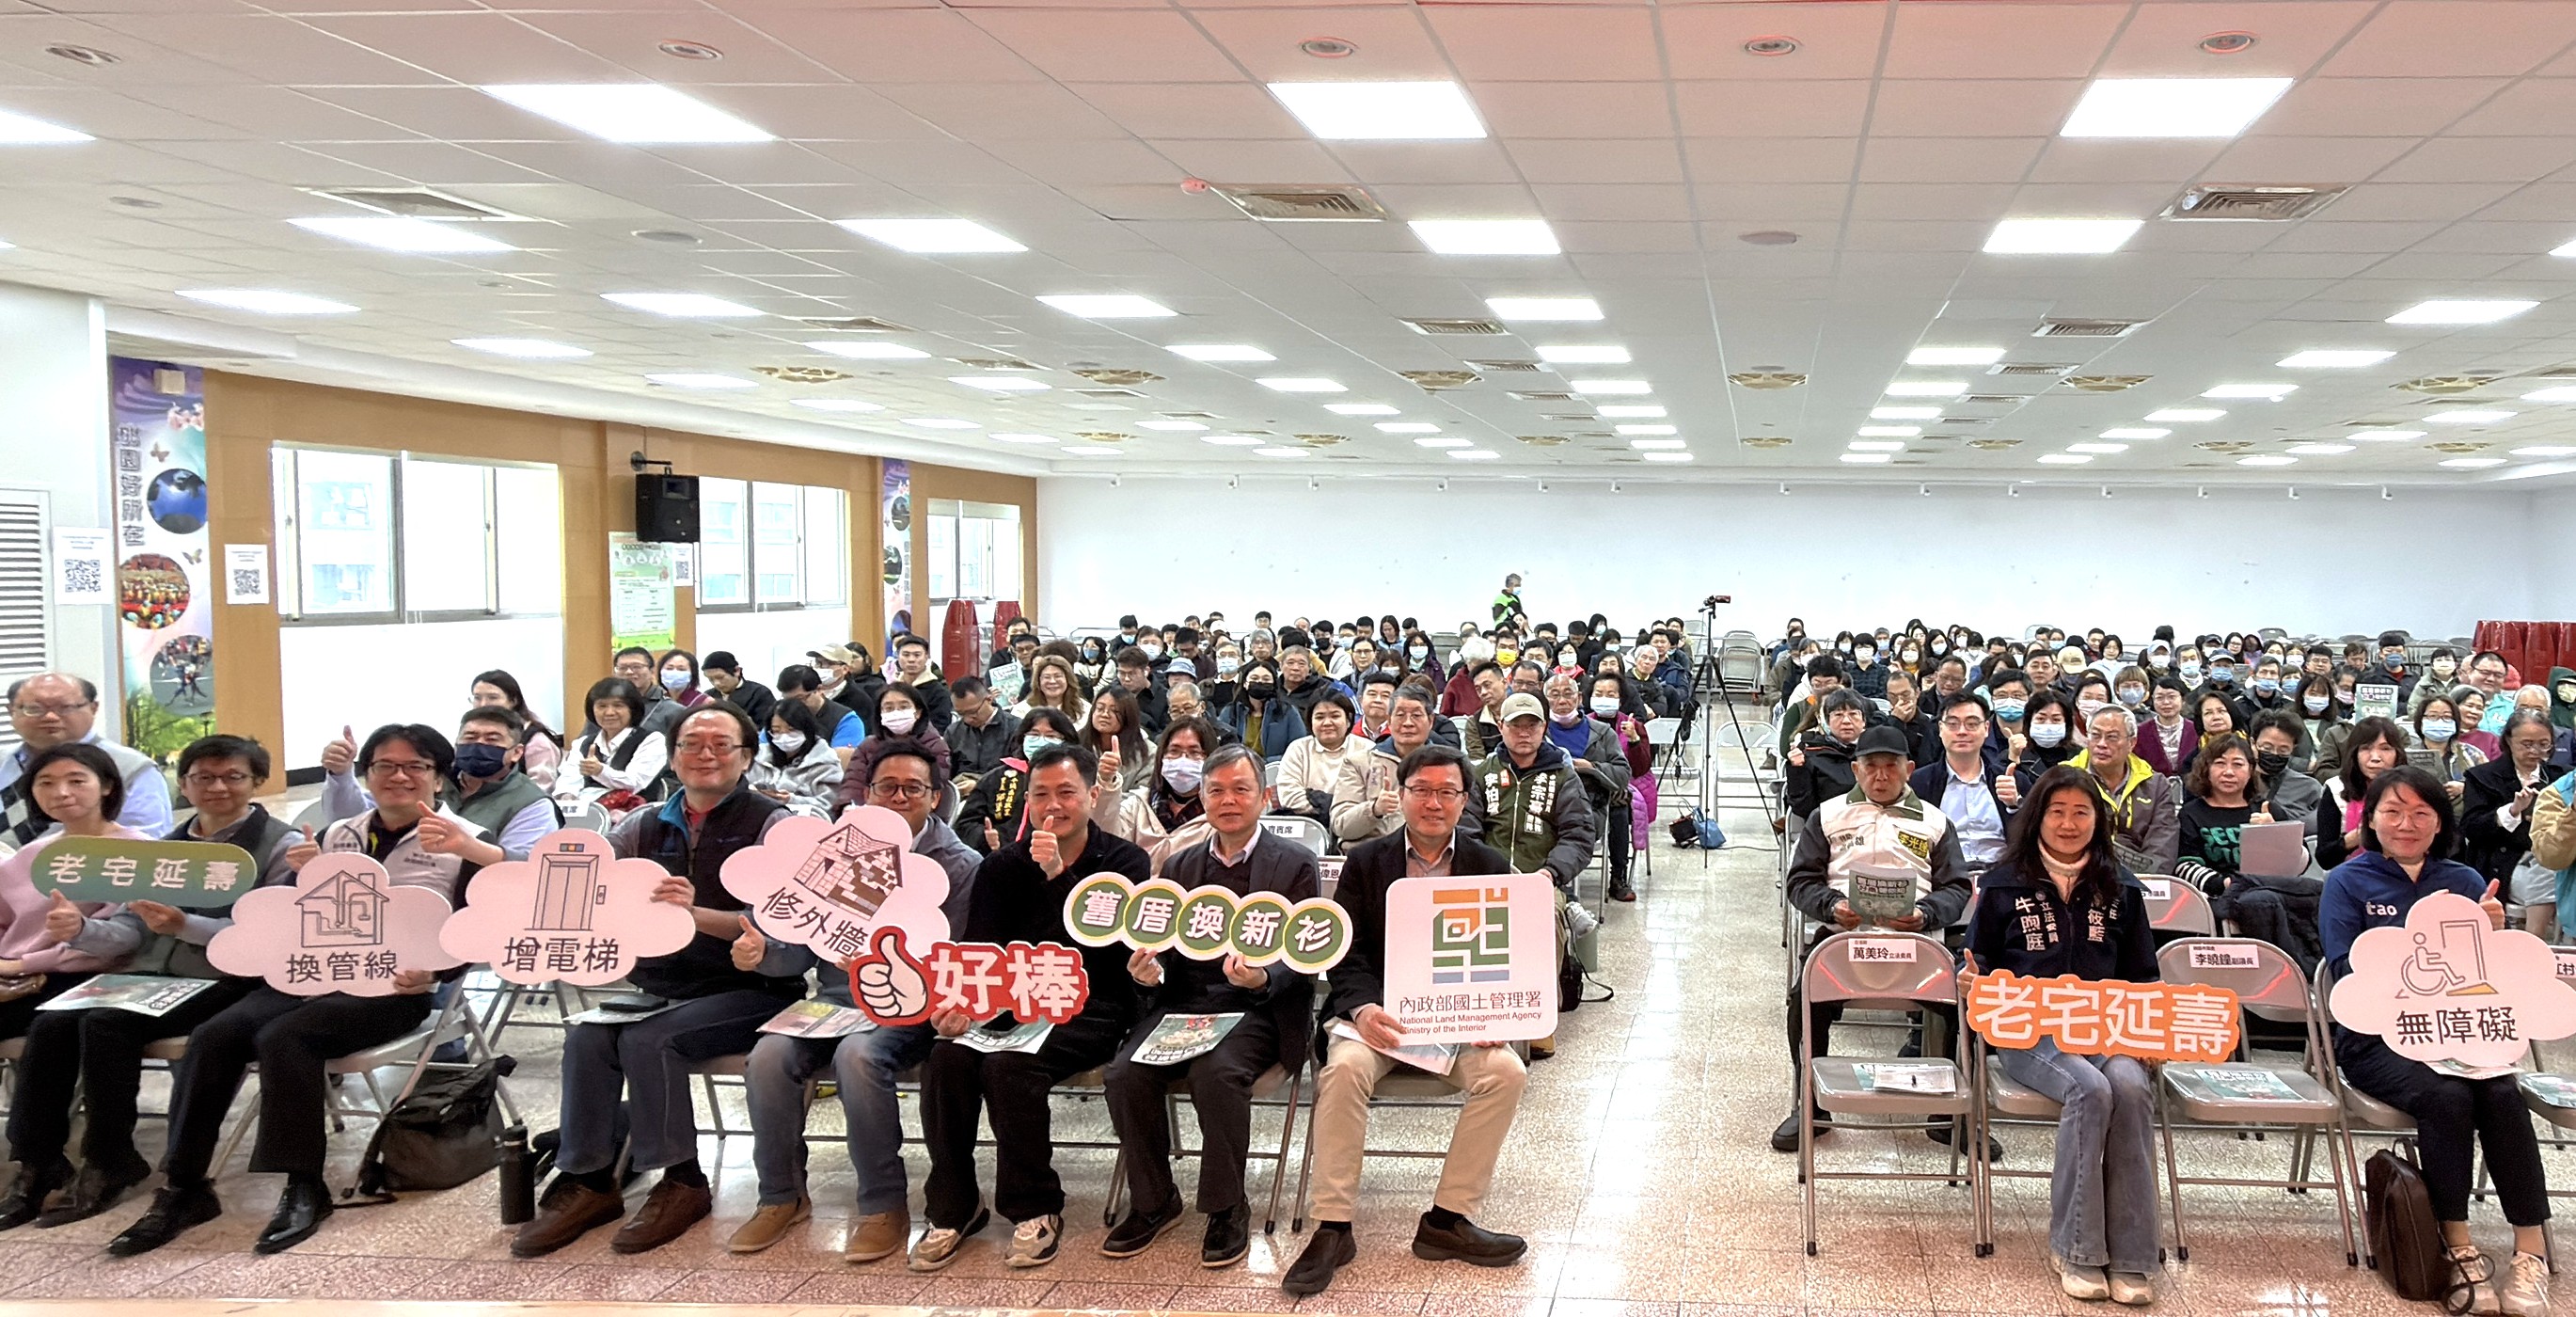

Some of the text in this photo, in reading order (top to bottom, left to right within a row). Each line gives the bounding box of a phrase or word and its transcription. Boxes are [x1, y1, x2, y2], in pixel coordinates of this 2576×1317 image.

[48, 852, 240, 891] 老宅延壽
[761, 886, 869, 958] 修外牆
[1082, 889, 1333, 953] 舊厝換新衫
[286, 949, 399, 984] 換管線
[501, 936, 620, 974] 增電梯
[929, 947, 1081, 1017] 好棒
[1399, 991, 1541, 1014] 內政部國土管理署
[1399, 1011, 1542, 1025] National Land Management Agency
[1975, 977, 2232, 1055] 老宅延壽
[1432, 1025, 1441, 1034] of
[1443, 1024, 1456, 1033] the
[1458, 1023, 1487, 1033] Interior
[2395, 1006, 2520, 1045] 無障礙
